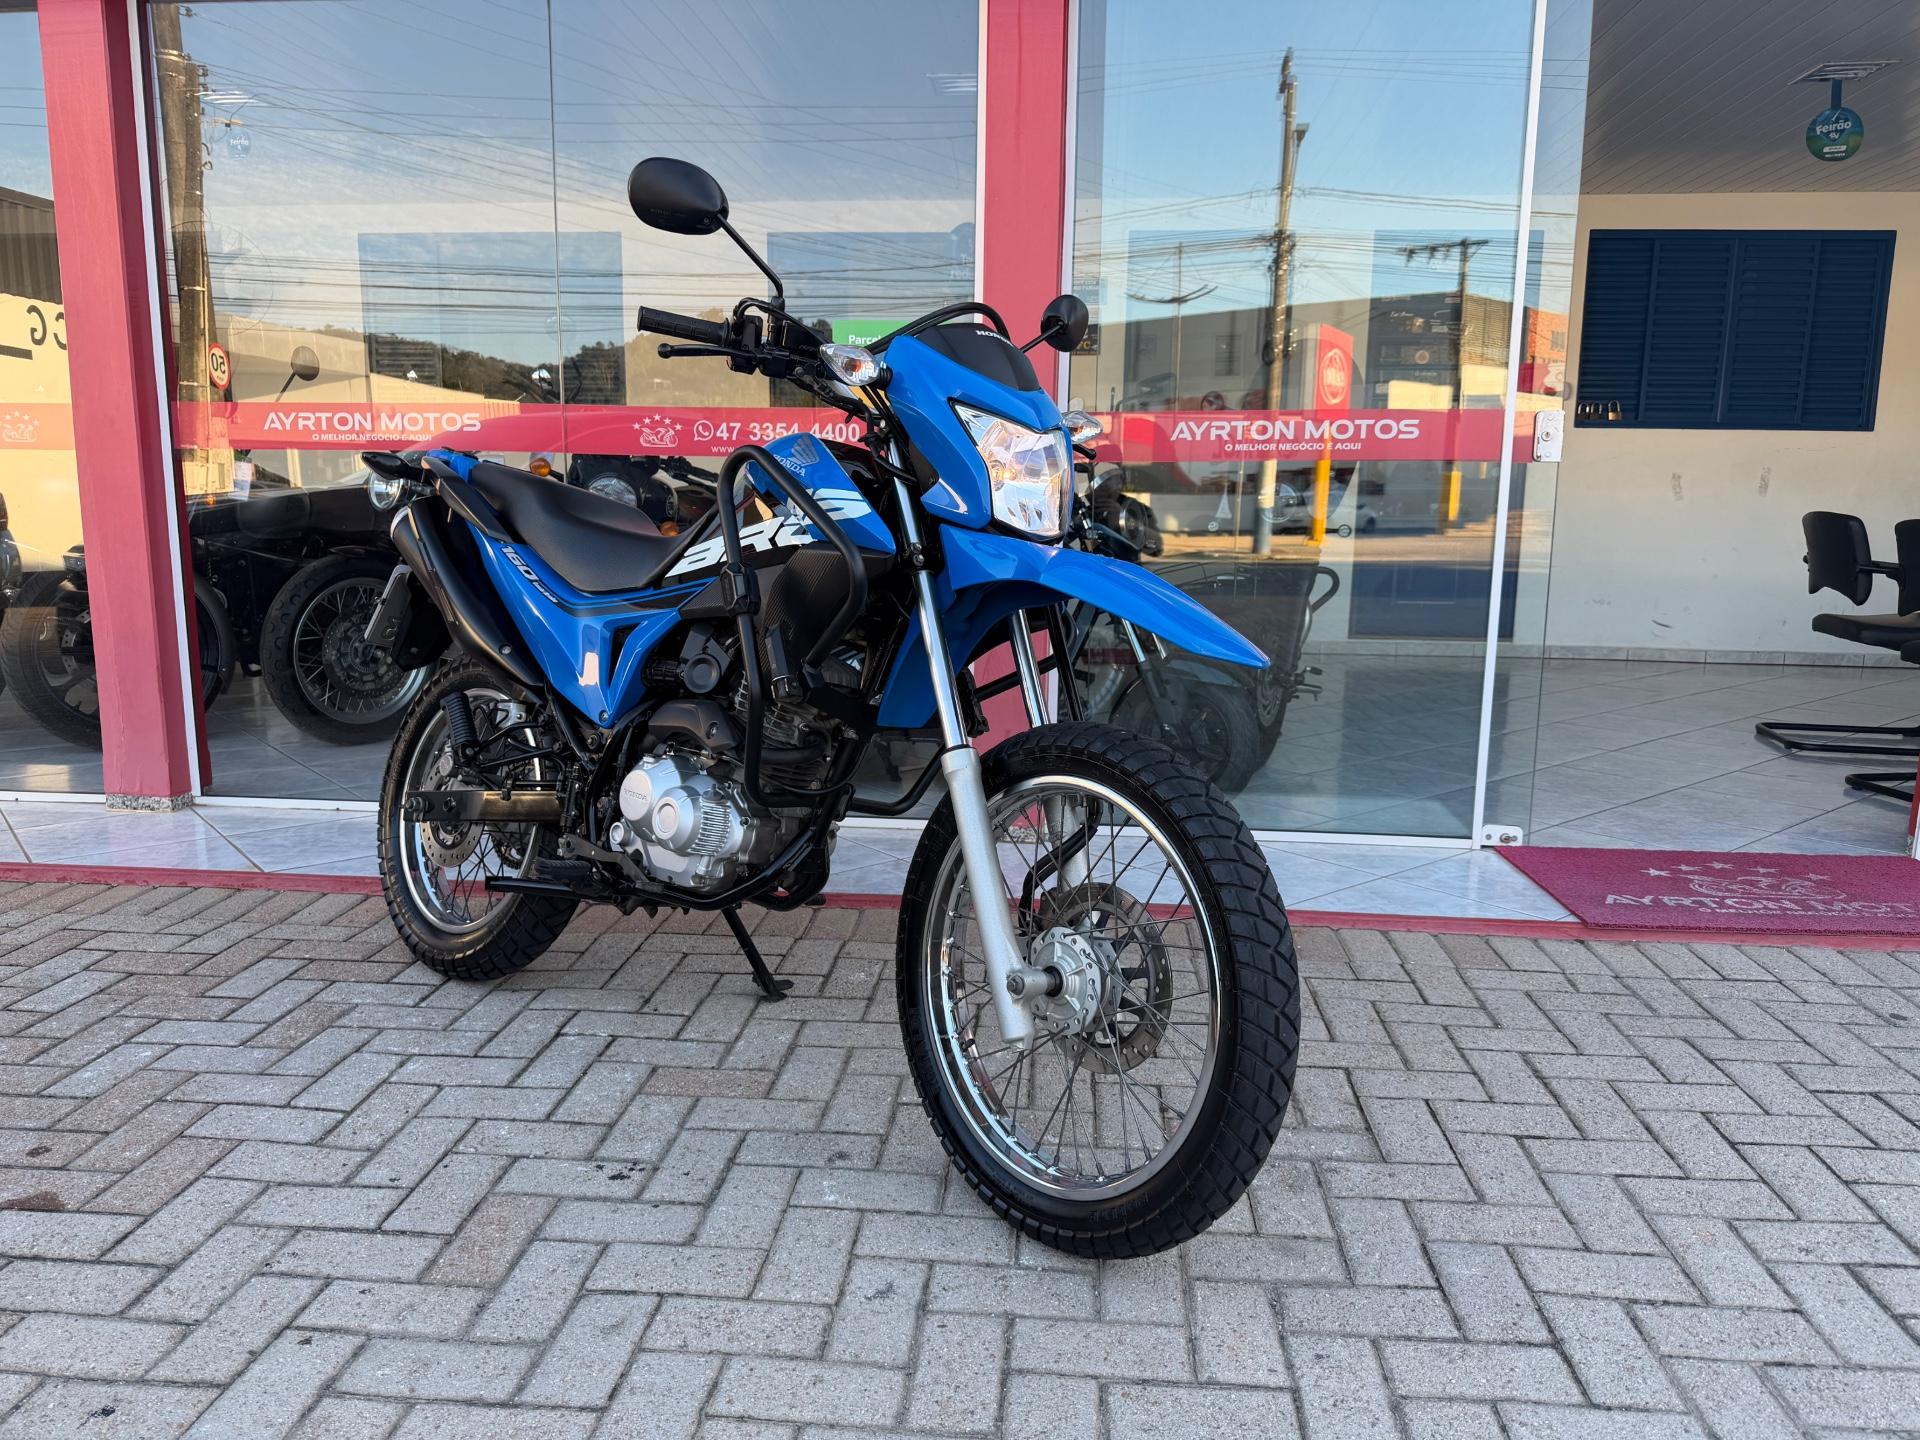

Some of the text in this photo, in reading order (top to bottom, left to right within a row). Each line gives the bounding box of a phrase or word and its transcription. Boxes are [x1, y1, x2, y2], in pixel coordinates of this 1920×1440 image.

[263, 412, 482, 432] AYRTON MOTOS
[716, 422, 860, 442] 47 3354 4400
[1170, 419, 1420, 441] AYRTON MOTOS
[321, 433, 358, 441] MELHOR
[1224, 443, 1233, 451] O
[1234, 443, 1277, 451] MELHOR
[1278, 441, 1325, 451] NEGÓCIO
[1334, 442, 1362, 450] AQUI
[501, 545, 539, 580] 160
[1605, 894, 1802, 910] AYRTON
